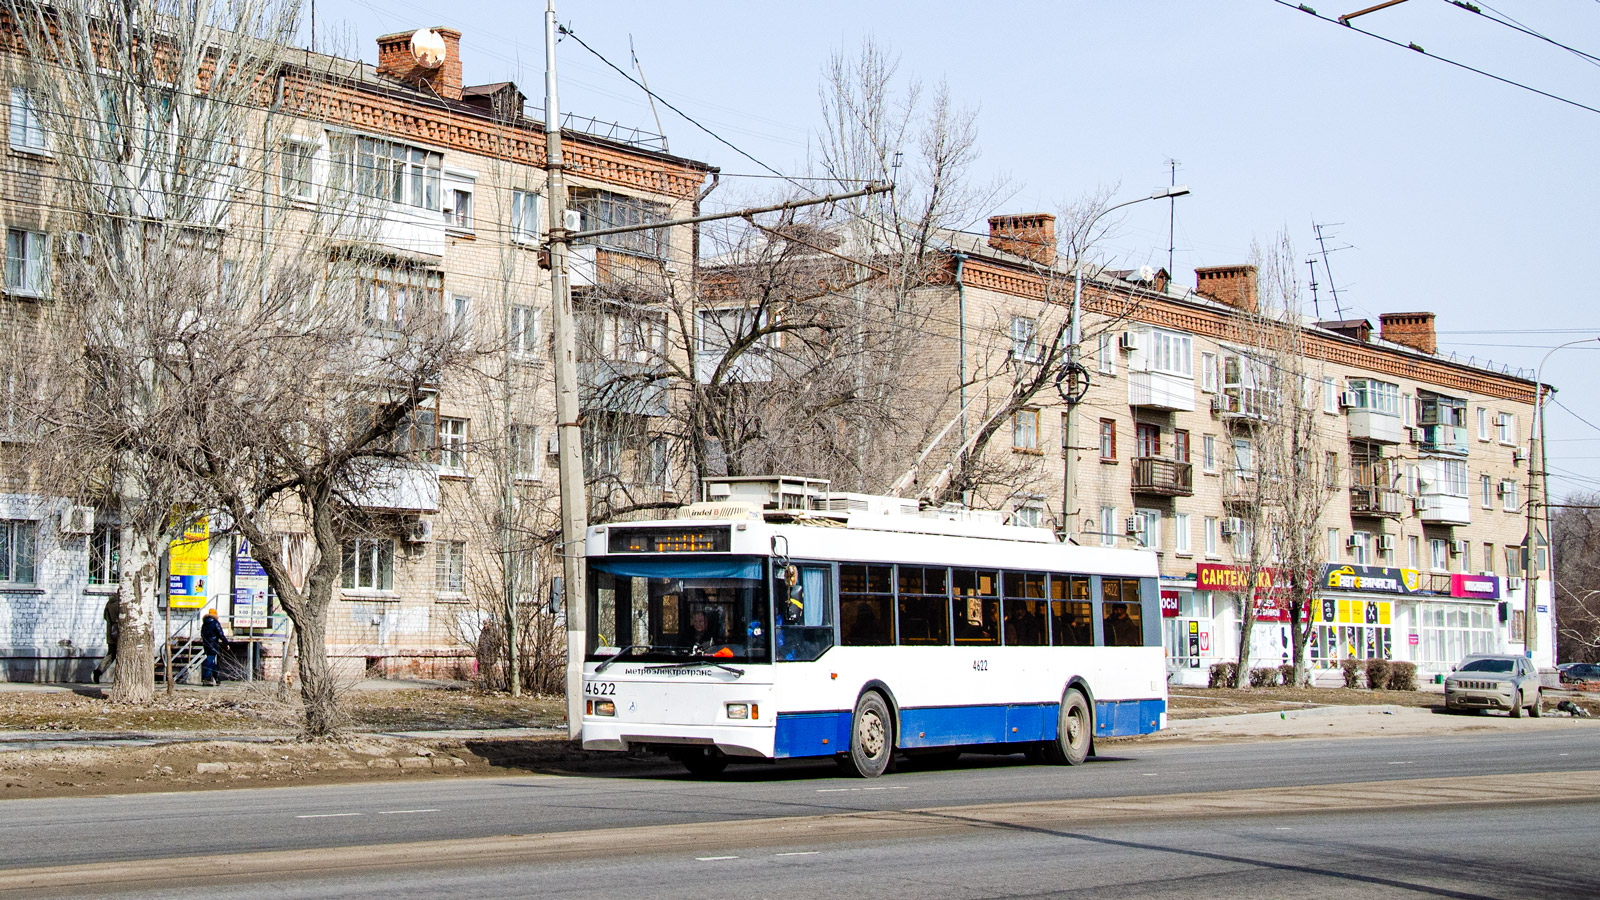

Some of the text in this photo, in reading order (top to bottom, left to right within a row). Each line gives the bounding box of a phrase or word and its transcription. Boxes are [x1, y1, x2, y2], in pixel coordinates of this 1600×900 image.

[691, 507, 713, 516] indel
[1201, 568, 1272, 588] САНТЕХНКА
[973, 659, 988, 672] 4622
[585, 682, 616, 695] 4622
